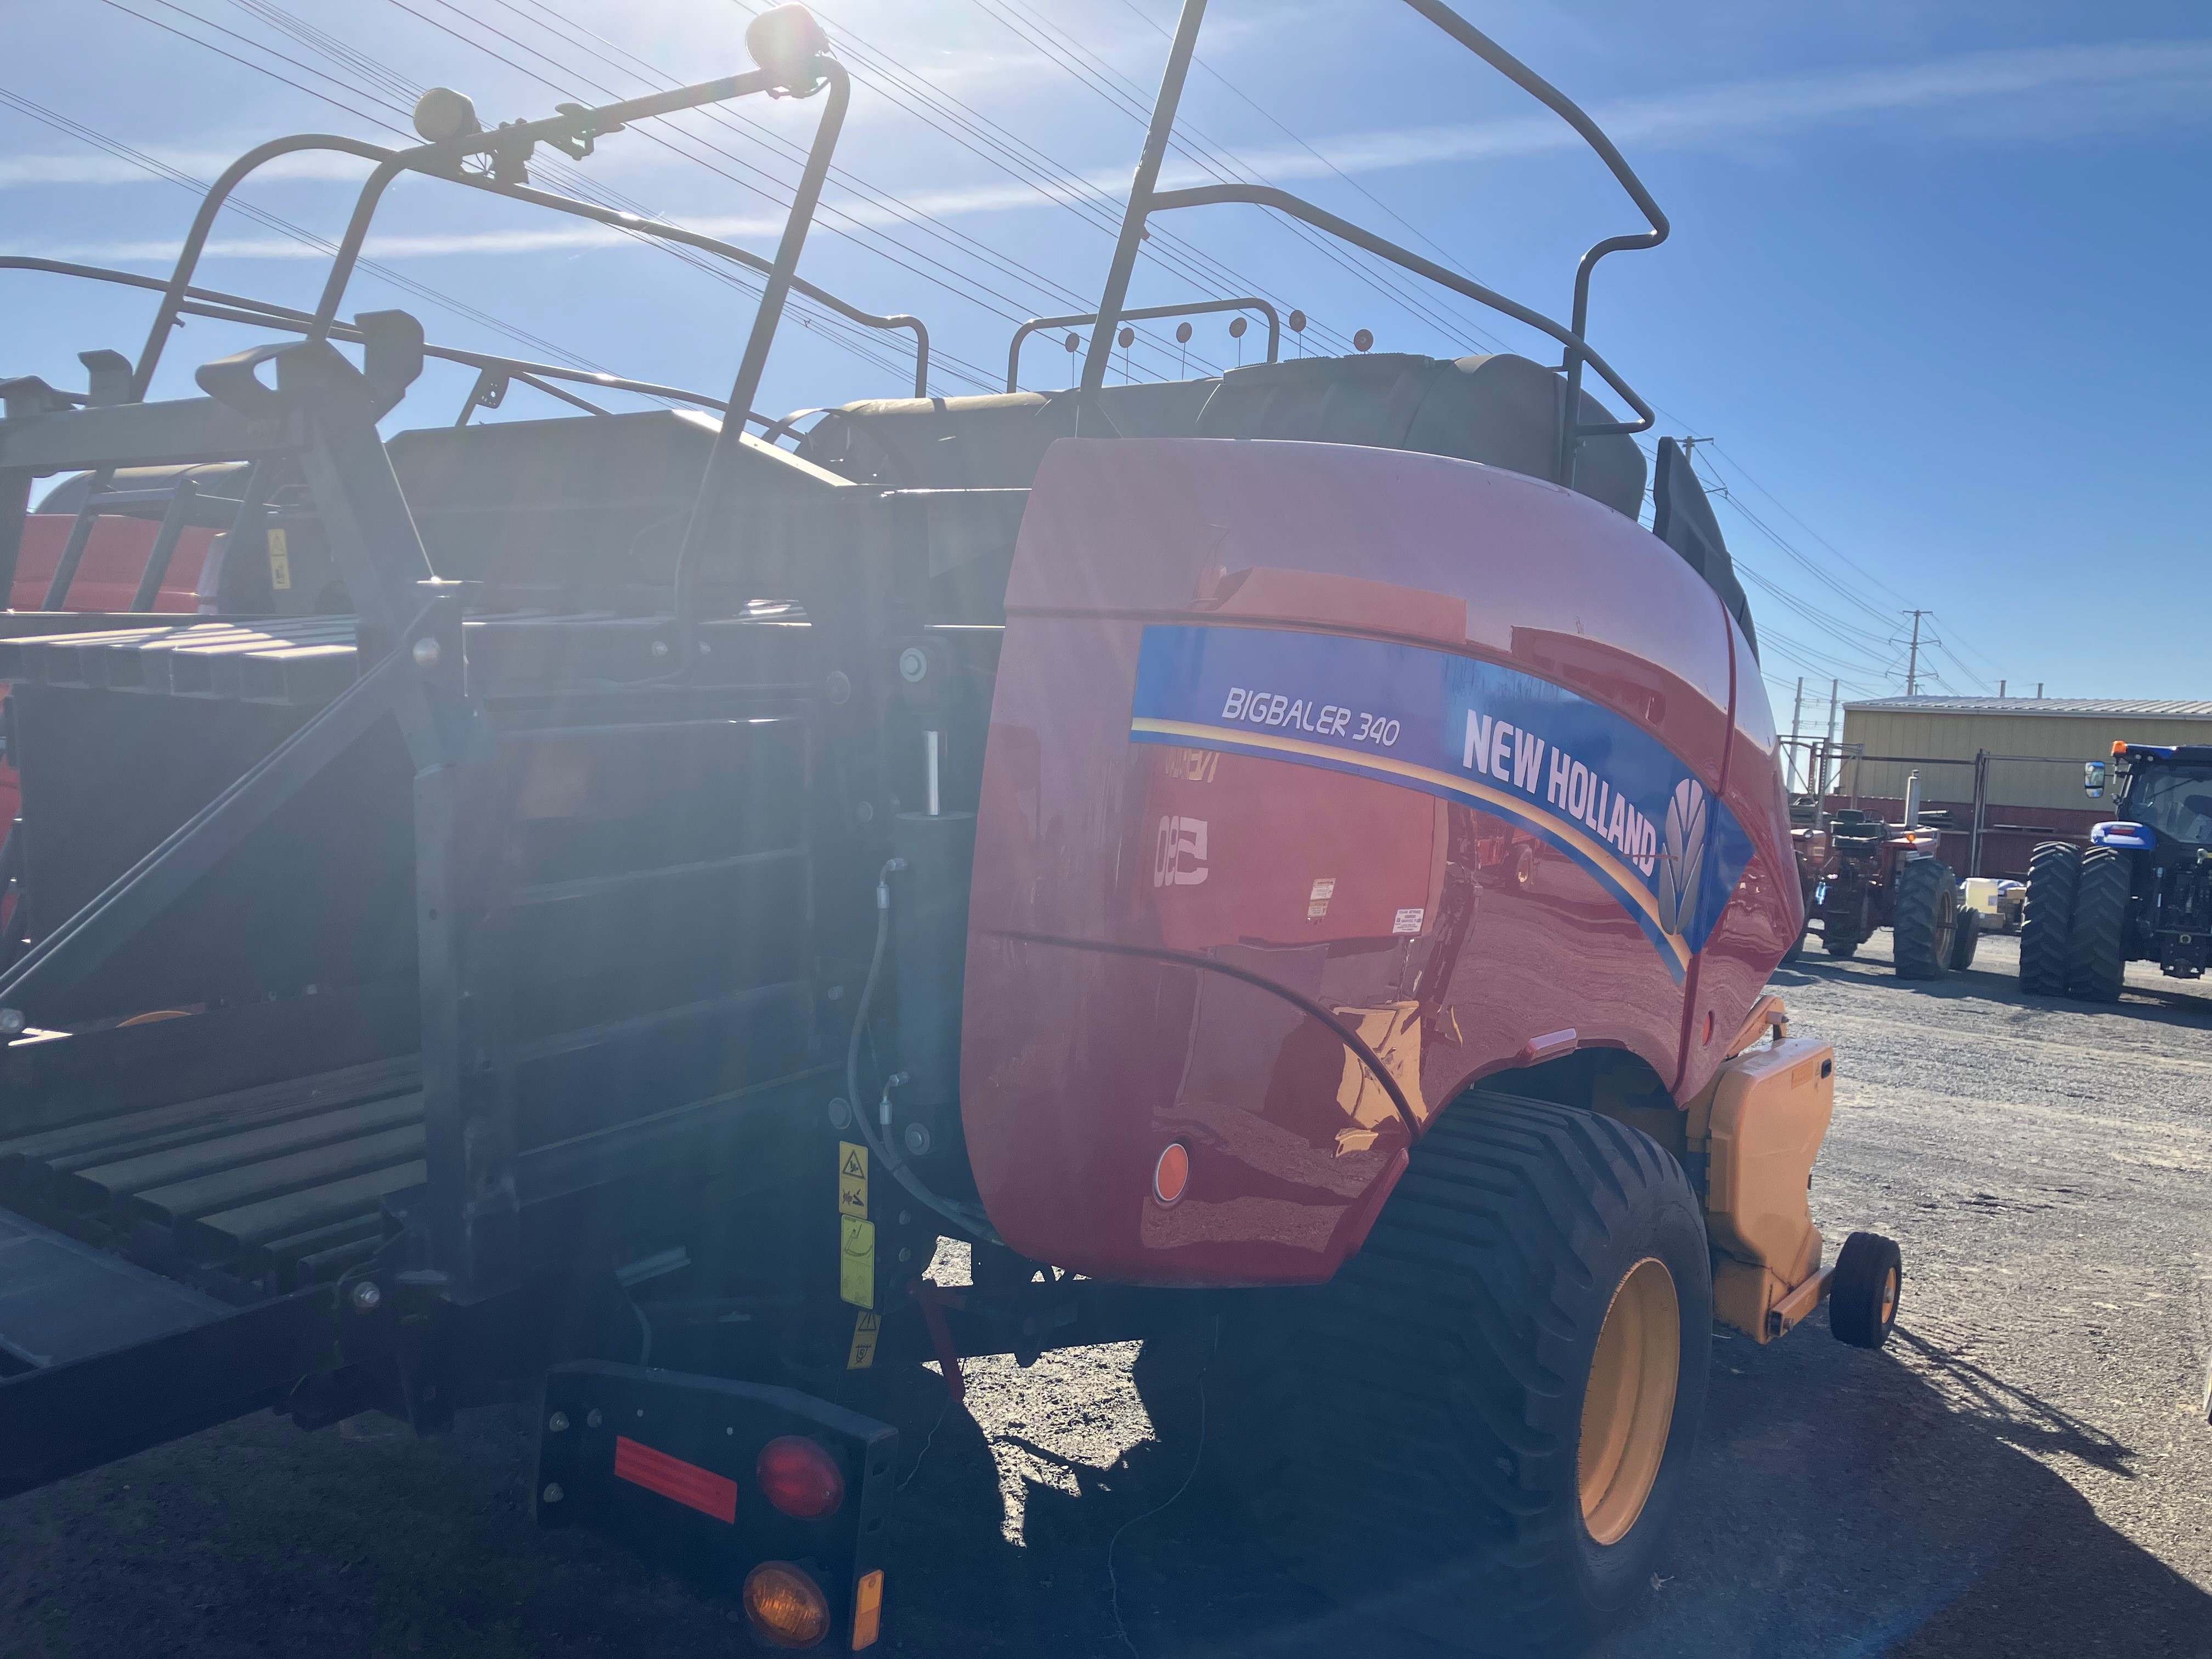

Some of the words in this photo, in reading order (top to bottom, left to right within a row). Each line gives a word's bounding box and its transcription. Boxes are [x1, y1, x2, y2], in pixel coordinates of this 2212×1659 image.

[1222, 687, 1351, 737] BIGBALER
[1352, 712, 1400, 746] 340
[1463, 708, 1545, 794] NEW
[1547, 746, 1656, 877] HOLLAND
